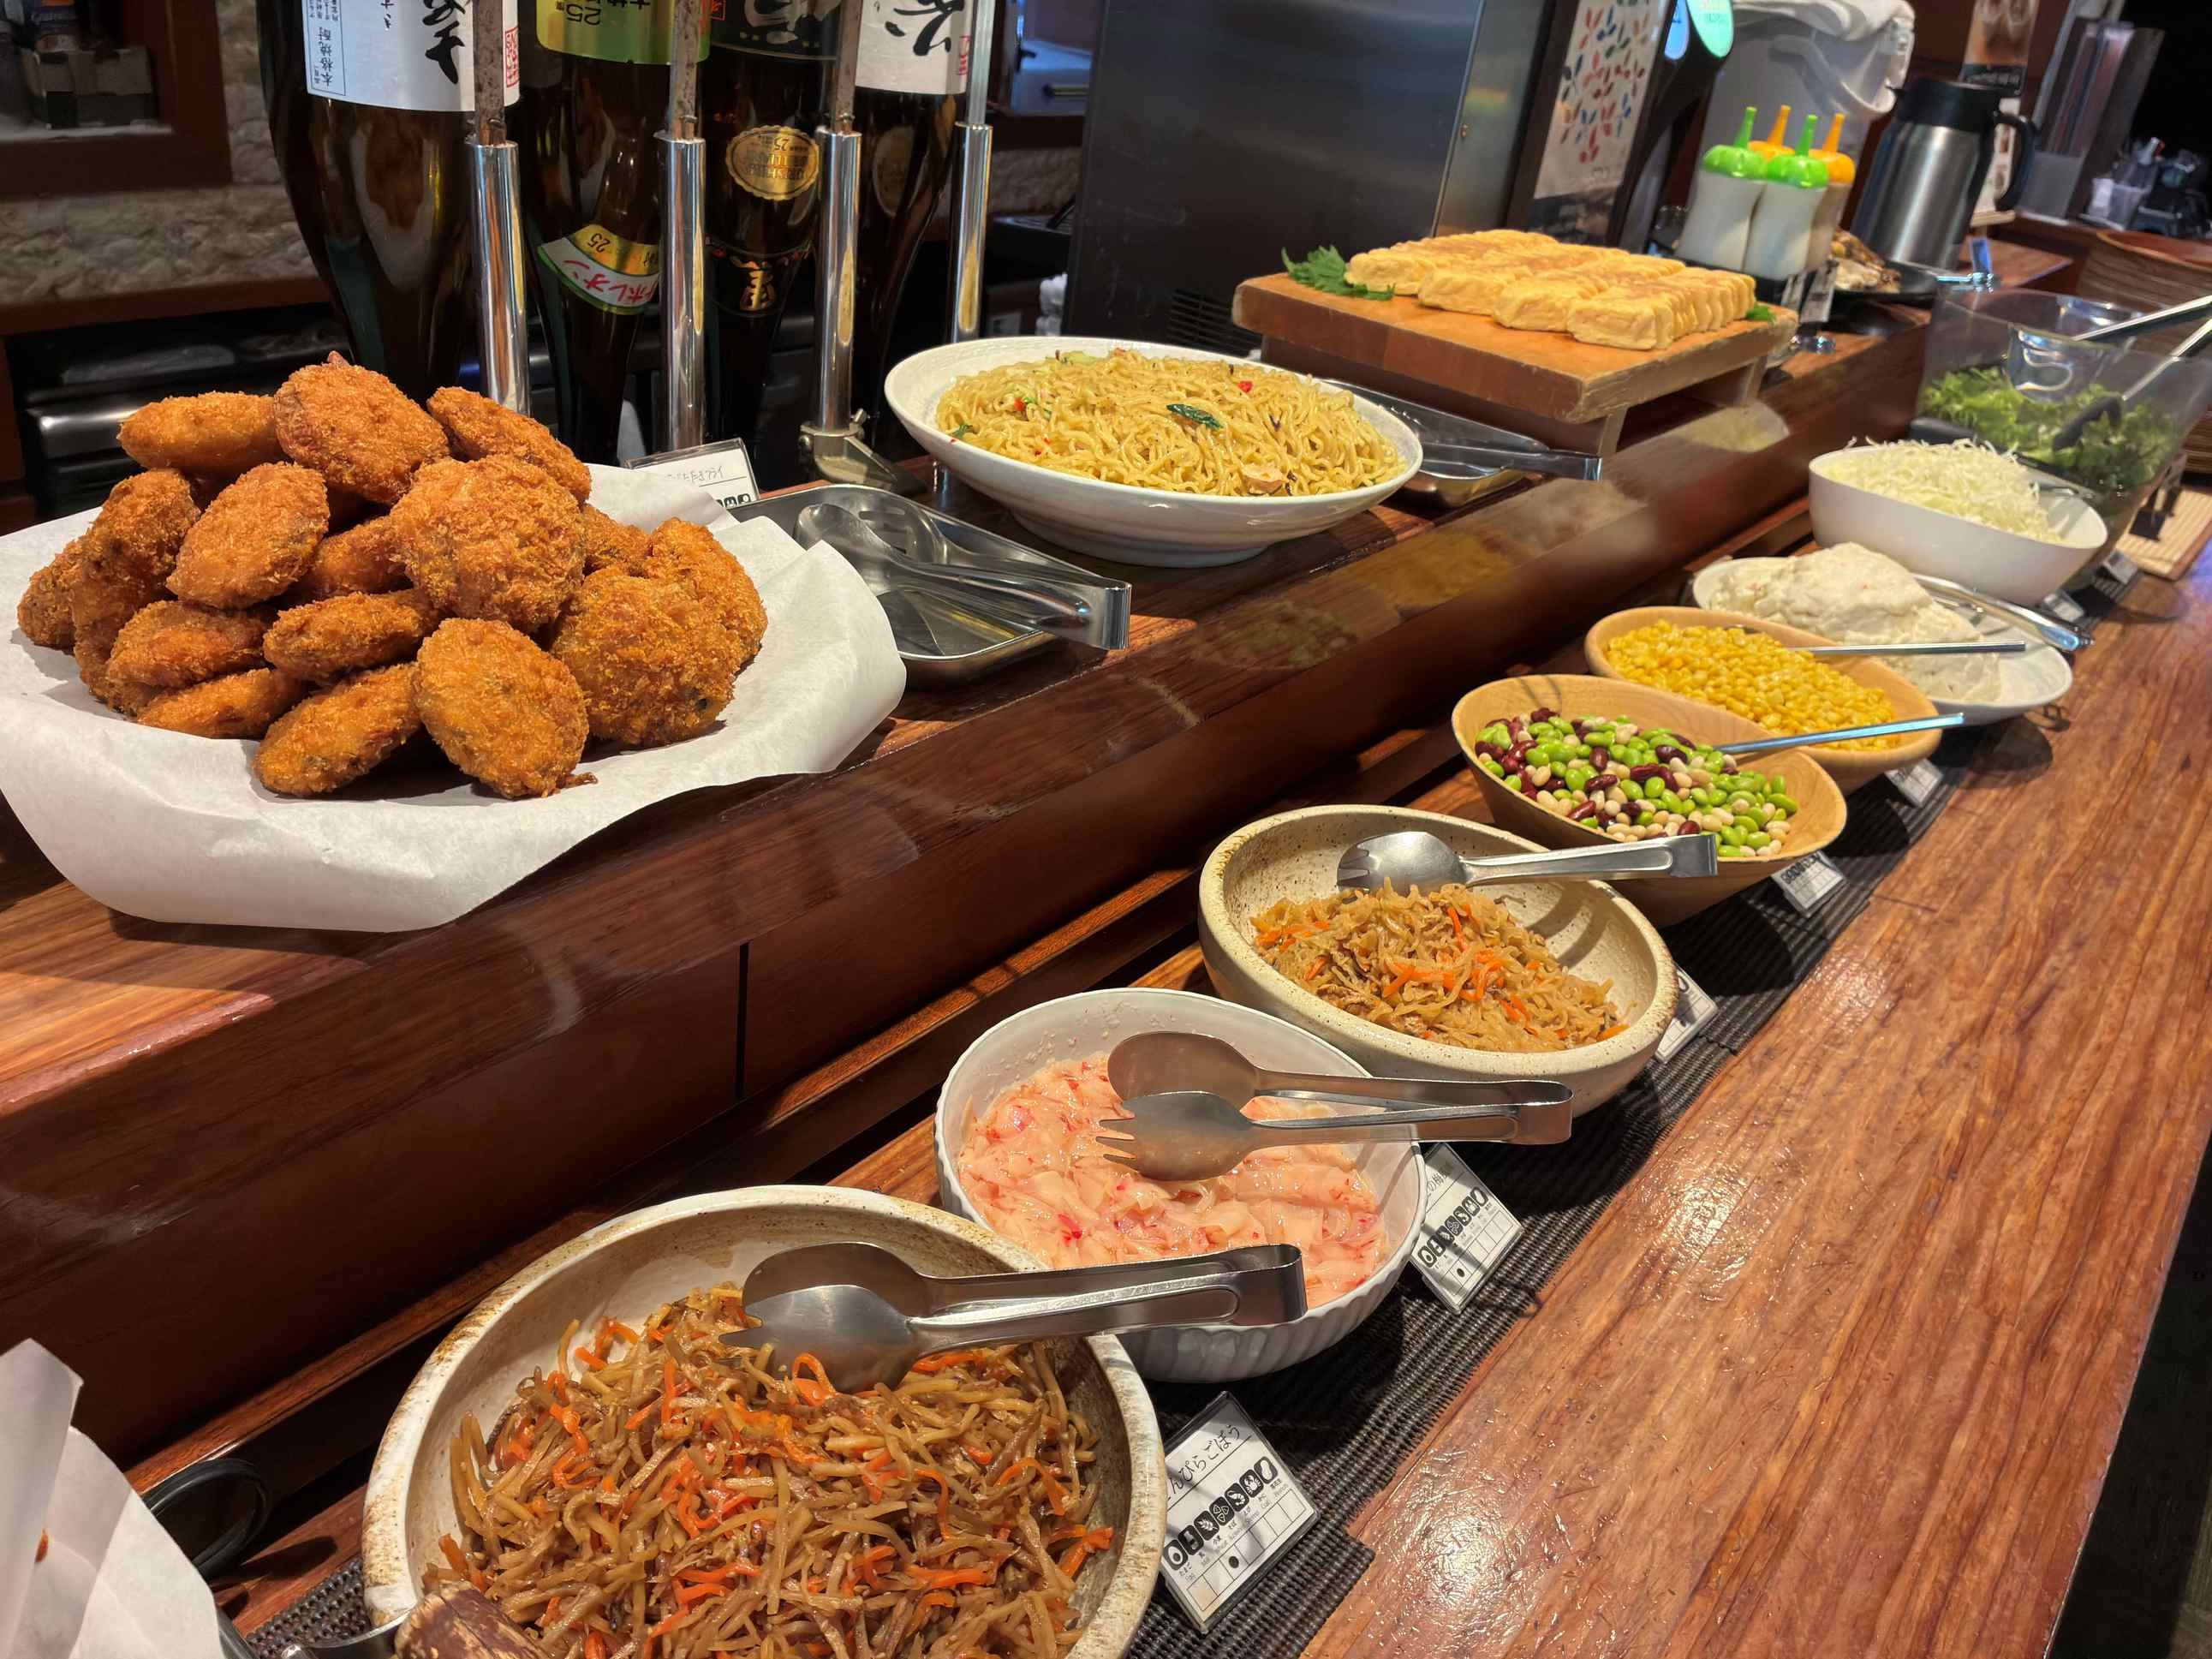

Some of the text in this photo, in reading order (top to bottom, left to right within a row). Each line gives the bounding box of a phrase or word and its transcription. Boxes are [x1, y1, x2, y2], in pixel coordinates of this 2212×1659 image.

[587, 233, 611, 254] 25
[1168, 1424, 1241, 1500] んぴらごぼう
